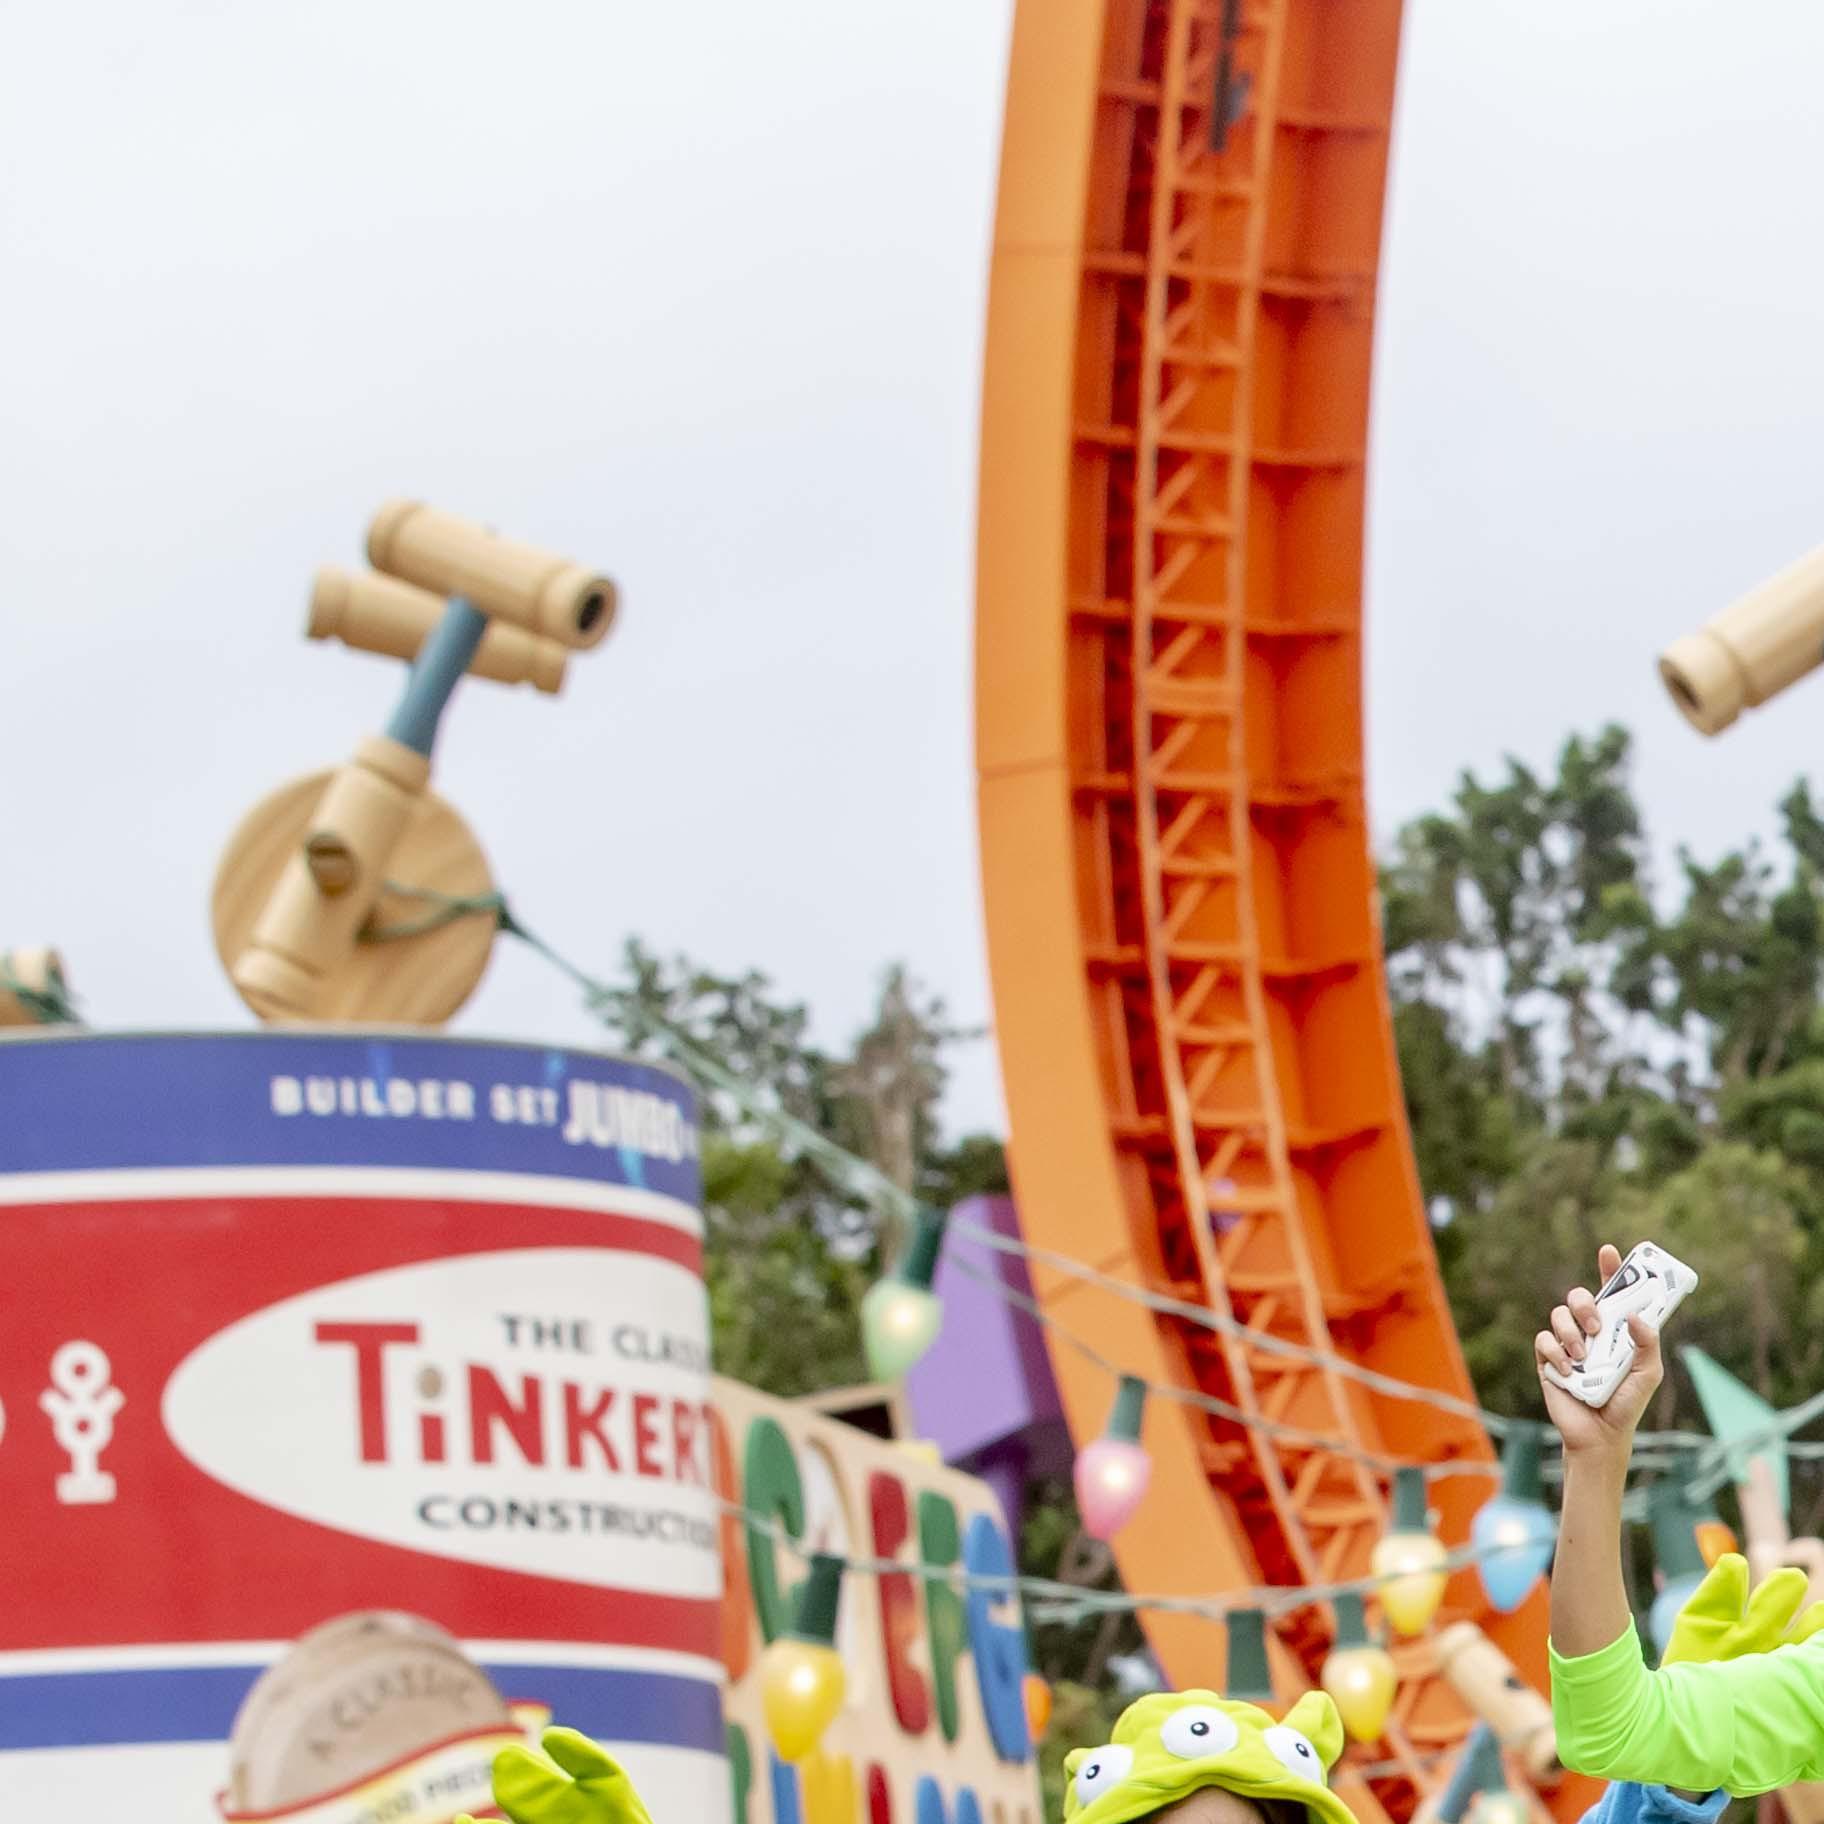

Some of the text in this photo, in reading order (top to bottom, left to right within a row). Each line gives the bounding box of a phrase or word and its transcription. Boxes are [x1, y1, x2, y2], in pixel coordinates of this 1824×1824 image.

[271, 1076, 475, 1120] BUILDER
[491, 1082, 558, 1126] SET
[501, 1313, 593, 1353] THE
